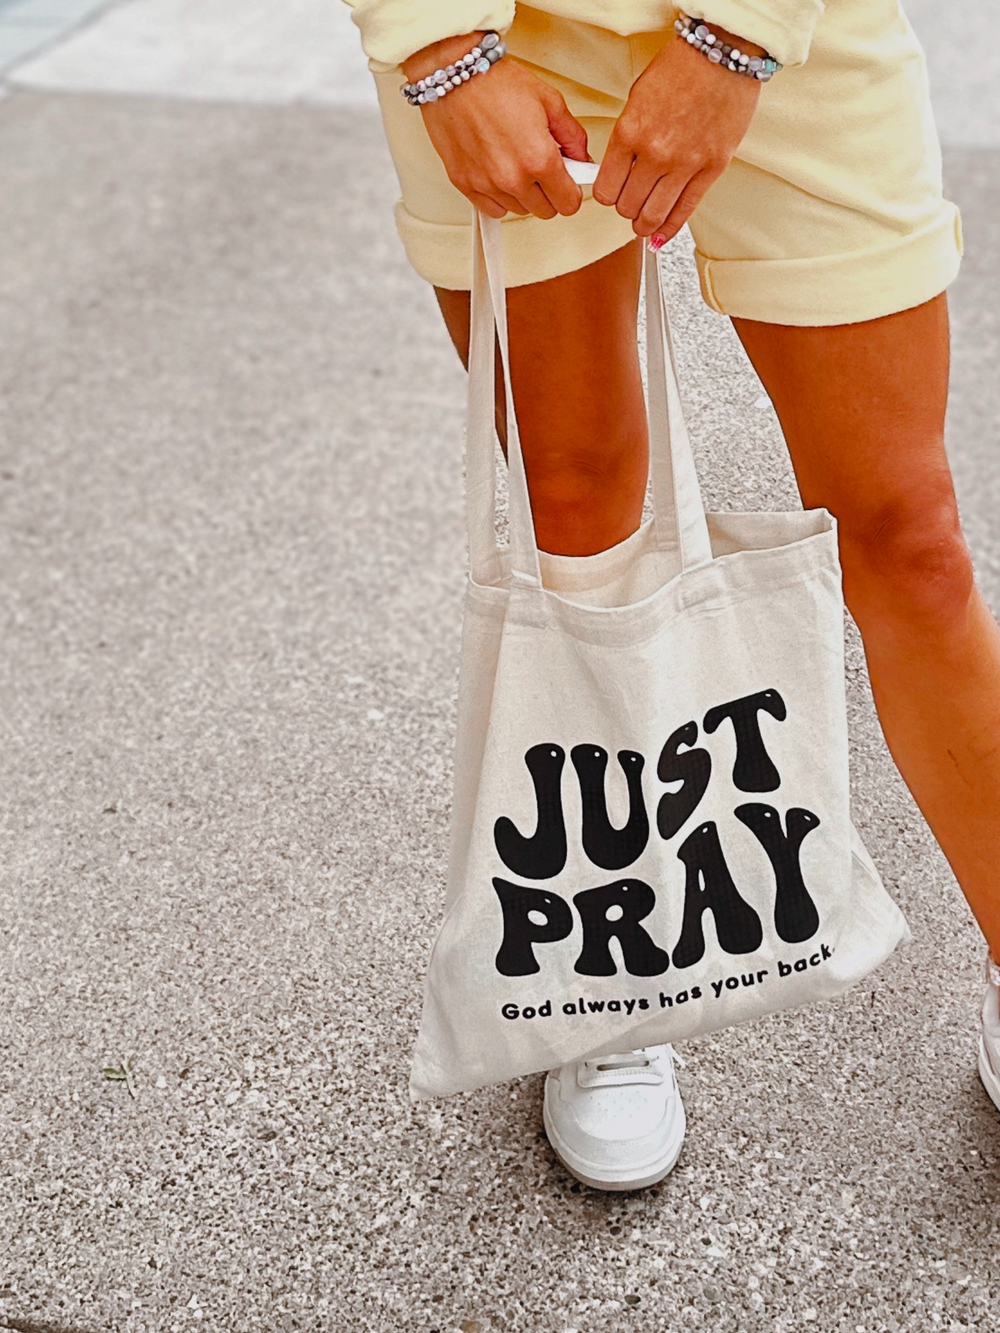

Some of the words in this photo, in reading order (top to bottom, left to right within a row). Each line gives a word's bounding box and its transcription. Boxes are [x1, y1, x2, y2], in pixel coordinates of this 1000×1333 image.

[494, 689, 786, 880] JUST
[492, 802, 820, 977] PRAY
[501, 999, 552, 1020] God
[562, 997, 650, 1016] always
[658, 987, 703, 1009] has
[711, 969, 769, 999] your
